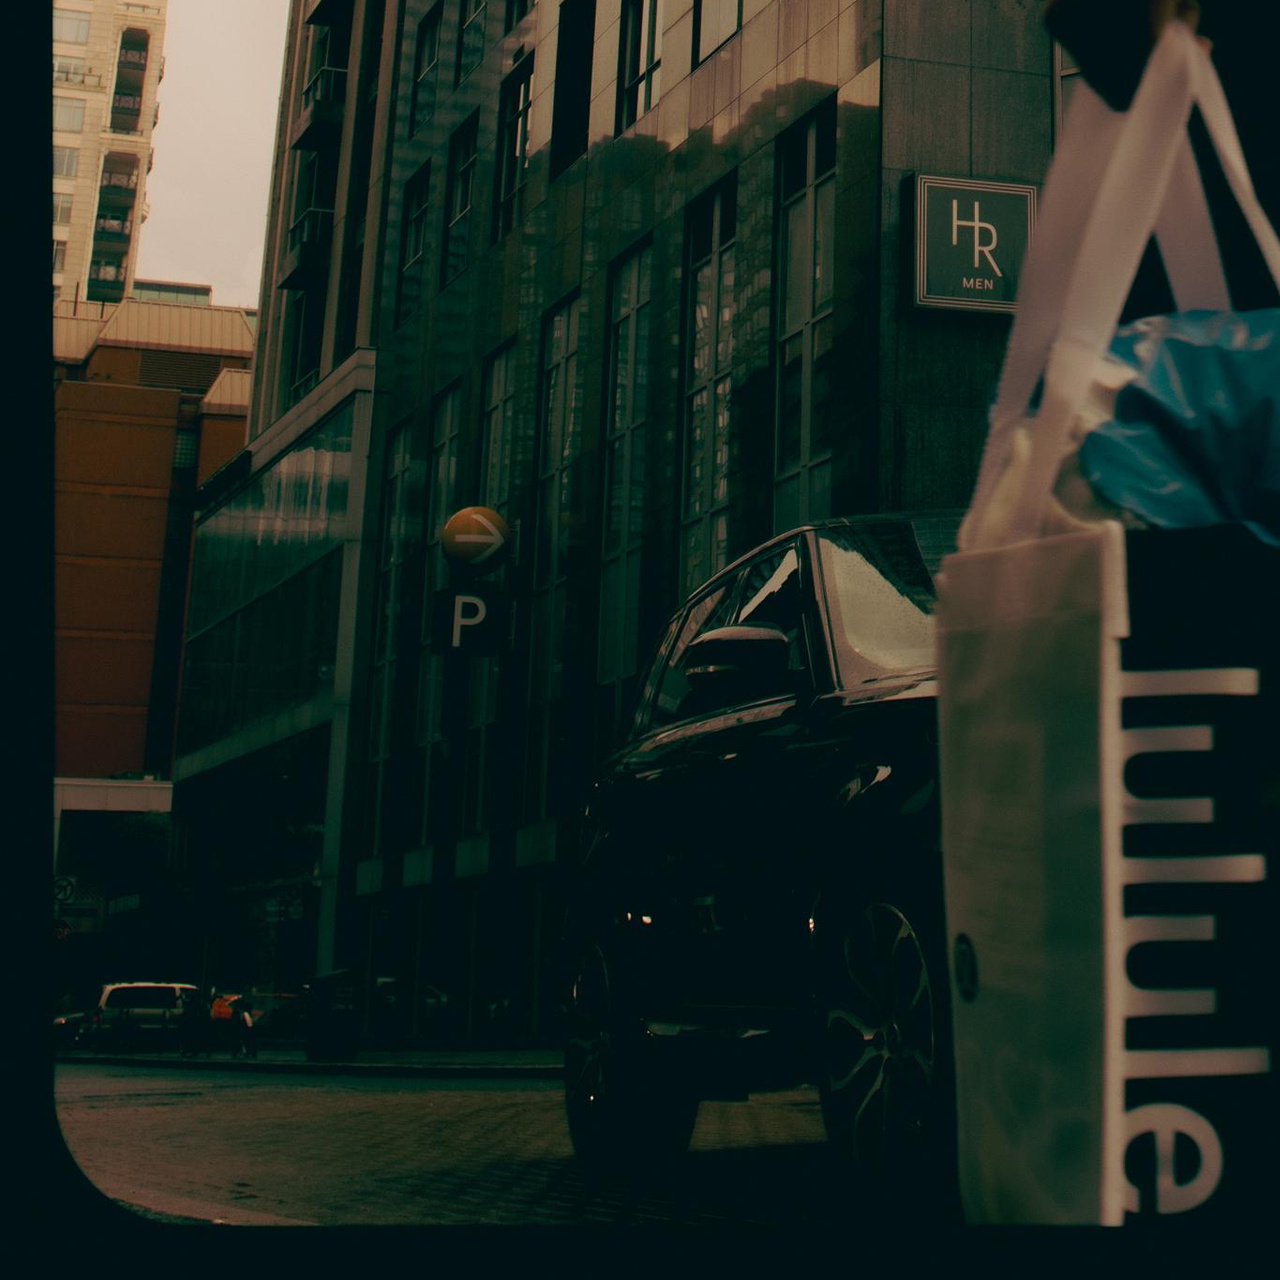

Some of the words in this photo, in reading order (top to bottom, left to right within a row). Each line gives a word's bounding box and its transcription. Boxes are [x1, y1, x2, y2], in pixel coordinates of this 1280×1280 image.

[951, 199, 1003, 278] HR
[962, 277, 994, 290] MEN
[451, 594, 488, 648] P
